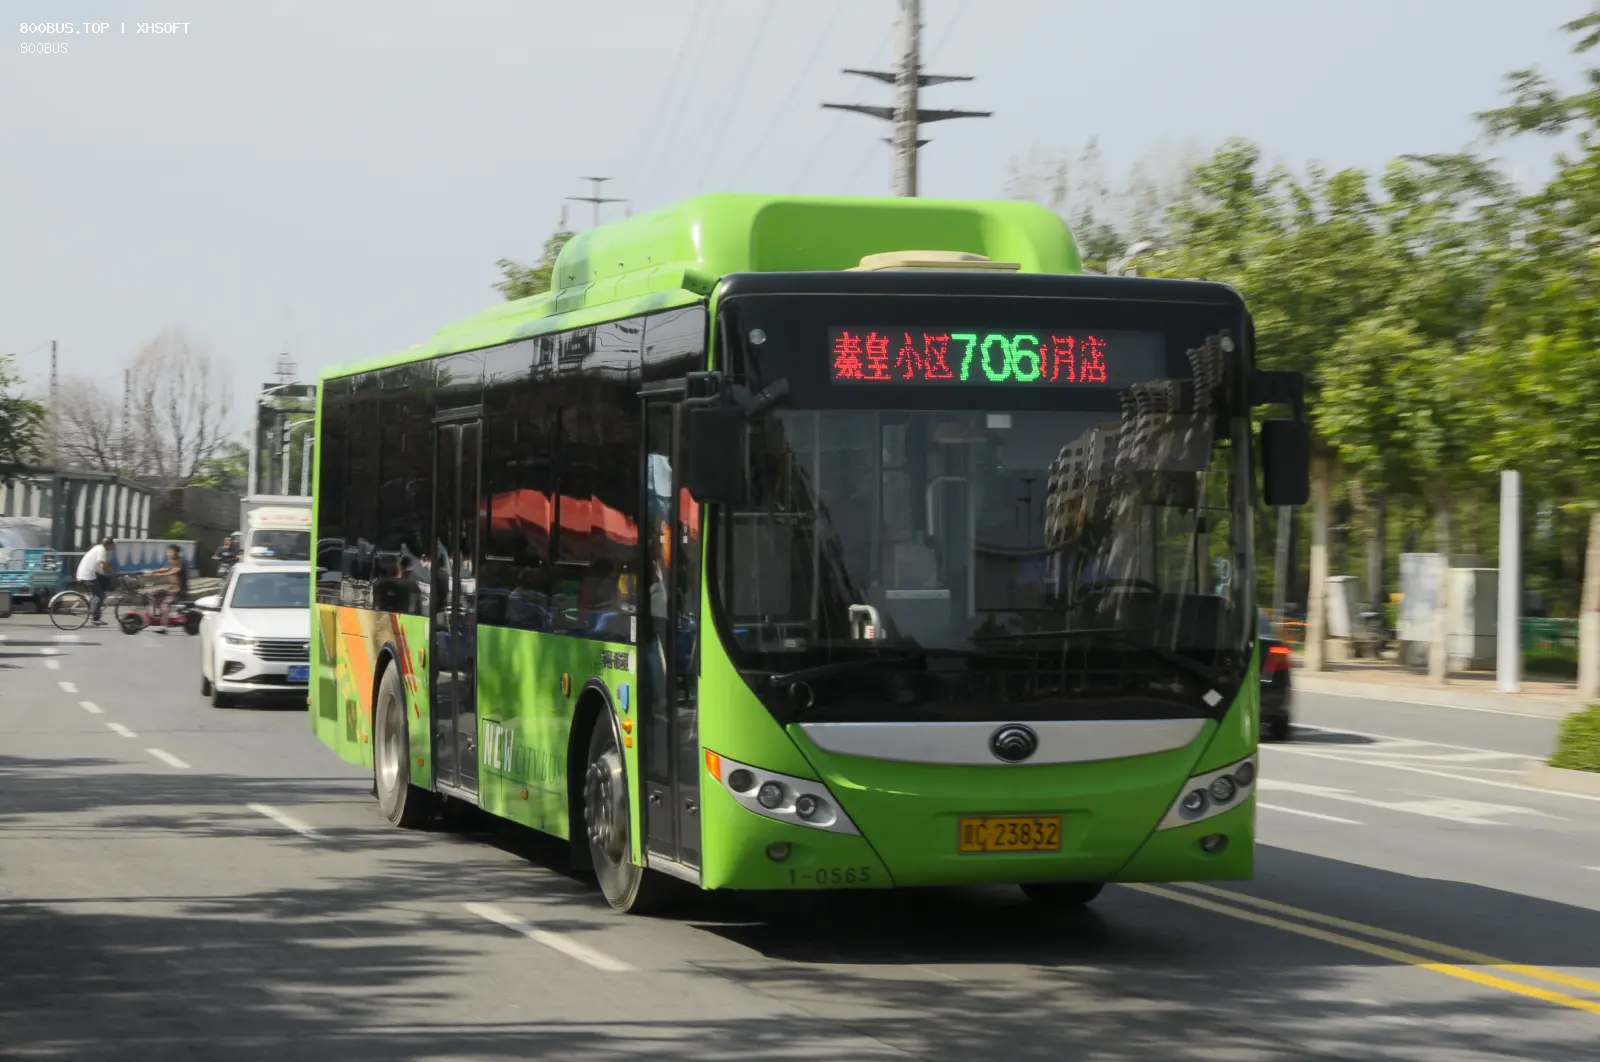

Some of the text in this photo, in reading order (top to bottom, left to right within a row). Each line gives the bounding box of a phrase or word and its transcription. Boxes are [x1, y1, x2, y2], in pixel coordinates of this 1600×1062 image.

[951, 333, 1040, 382] 706
[483, 723, 514, 772] NEW
[788, 866, 871, 885] 1-0565
